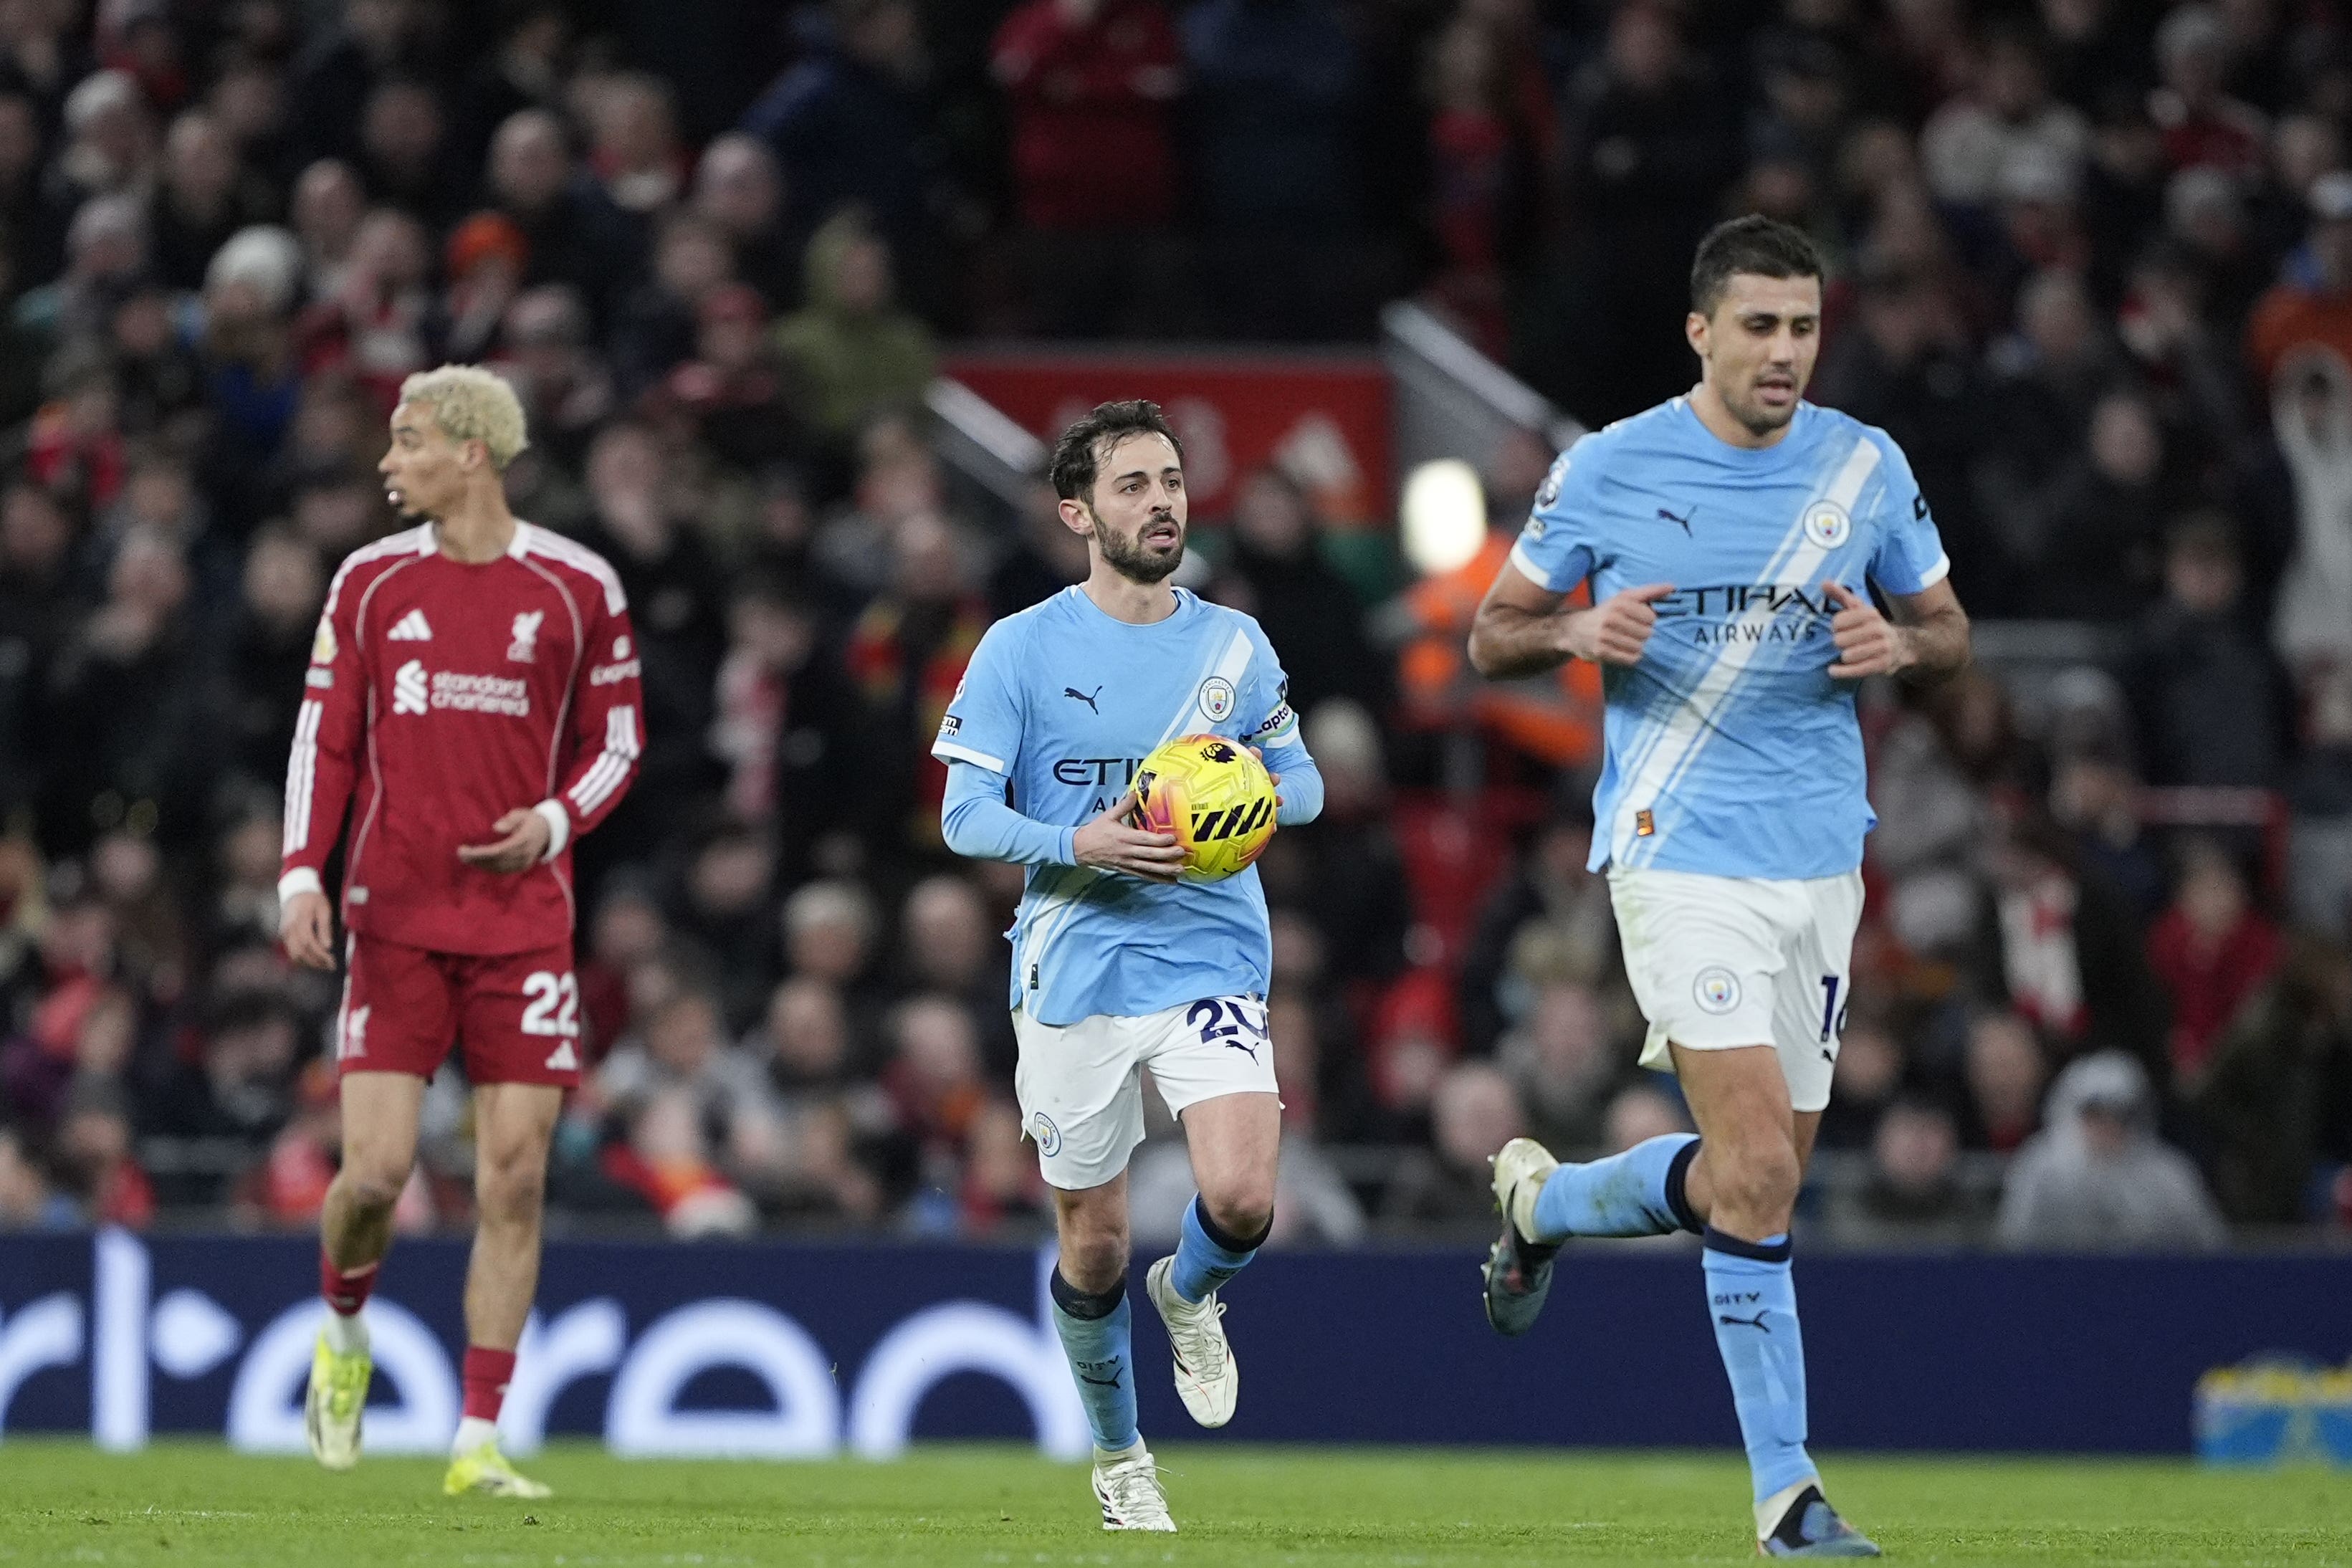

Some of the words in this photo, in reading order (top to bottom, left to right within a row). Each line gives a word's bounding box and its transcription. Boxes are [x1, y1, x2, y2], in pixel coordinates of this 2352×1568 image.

[1694, 622, 1818, 644] AIRWAYS
[432, 670, 527, 701] standard
[430, 690, 530, 717] chartered
[1254, 704, 1290, 735] apta
[1053, 758, 1145, 785] ETI
[520, 970, 579, 1038] 22
